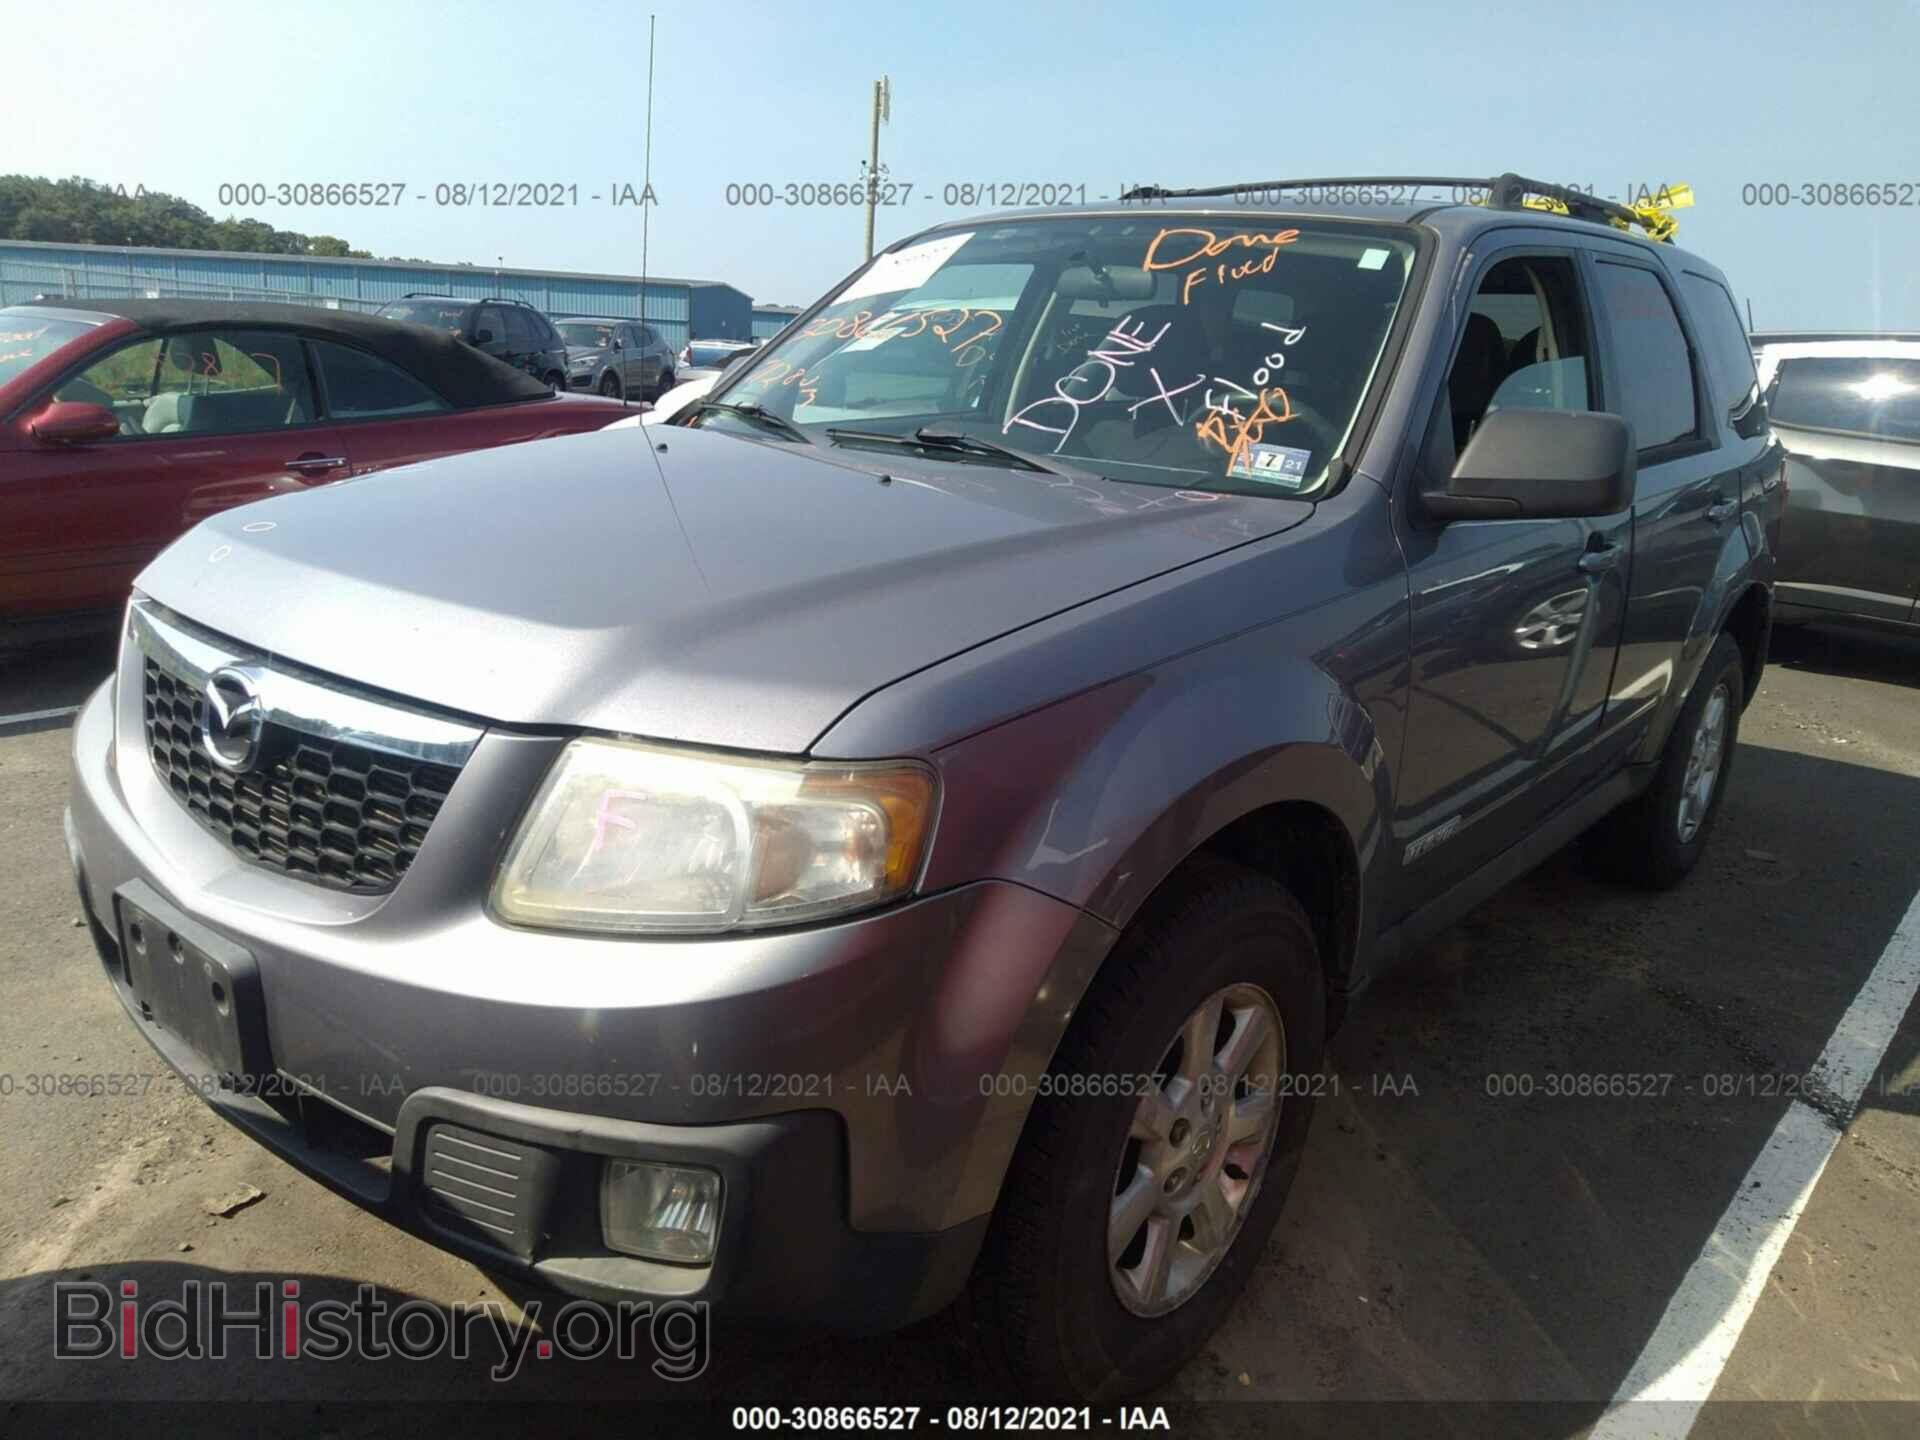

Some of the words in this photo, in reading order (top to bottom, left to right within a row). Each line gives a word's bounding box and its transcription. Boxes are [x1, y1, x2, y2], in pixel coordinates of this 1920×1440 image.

[1142, 228, 1300, 271] Done
[1001, 314, 1172, 453] DONE
[1265, 453, 1277, 467] 7
